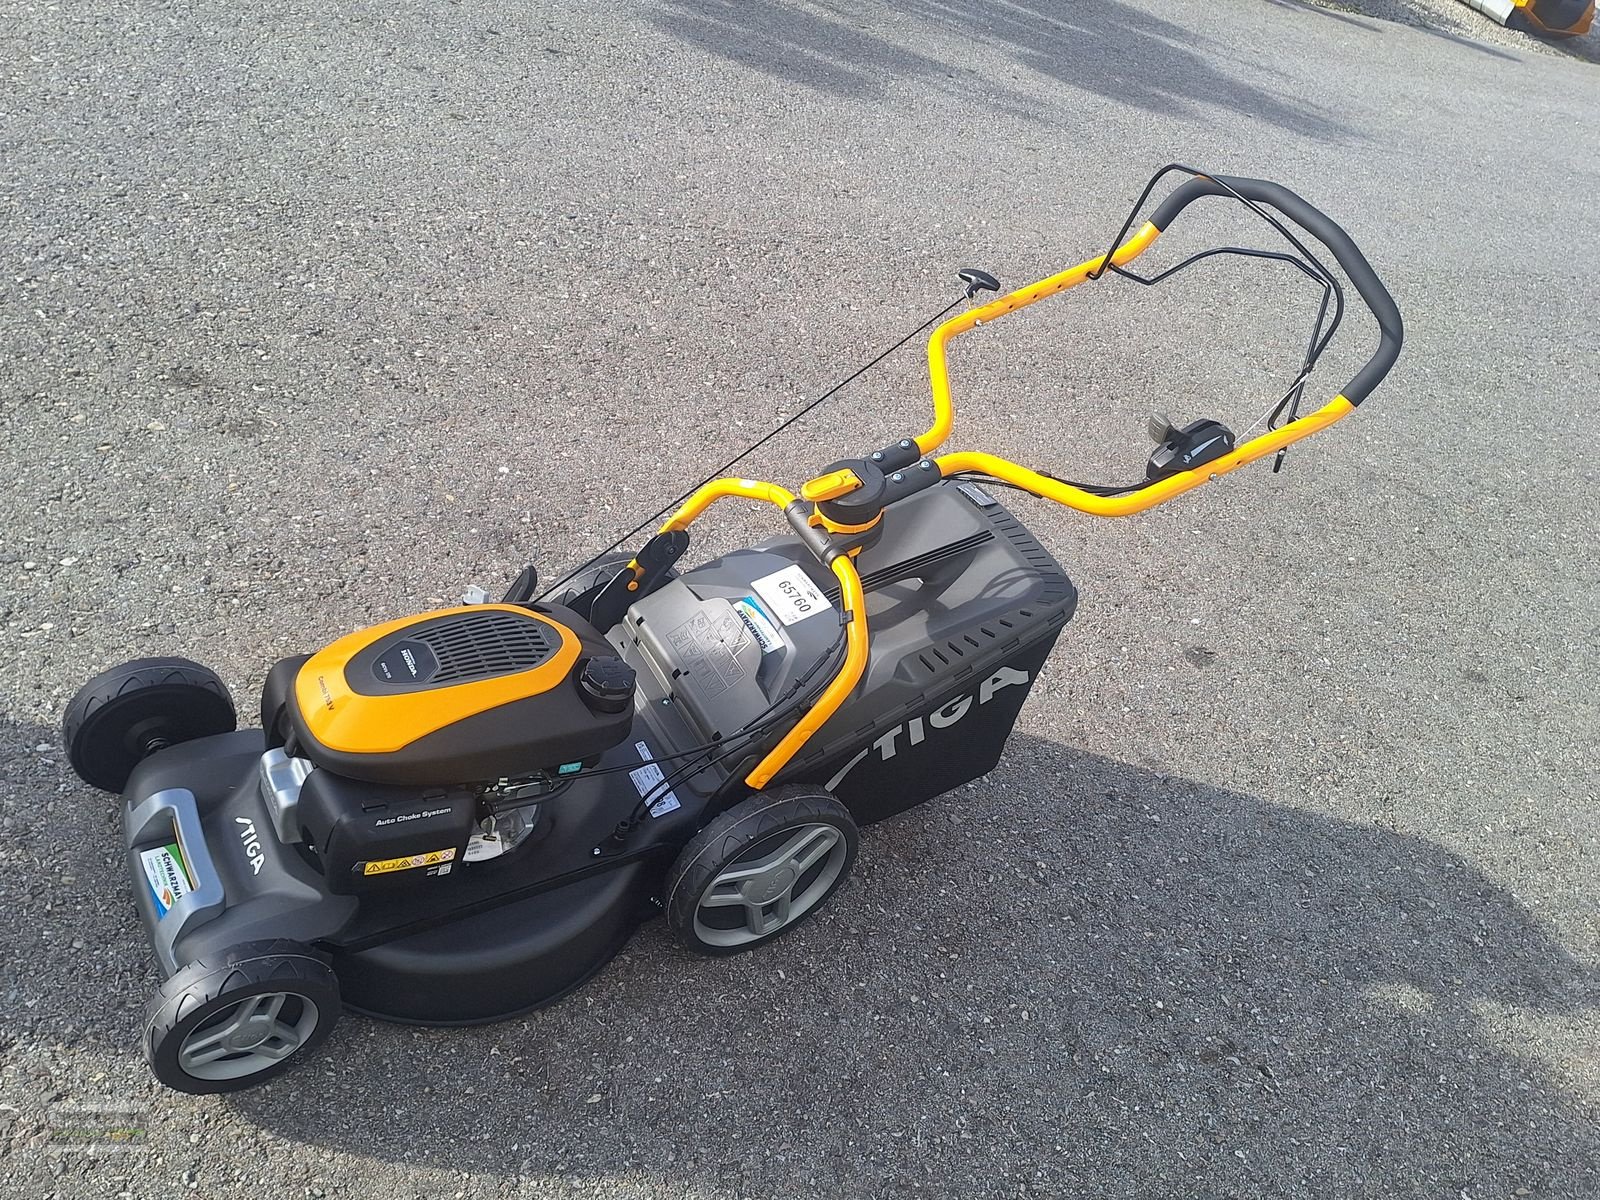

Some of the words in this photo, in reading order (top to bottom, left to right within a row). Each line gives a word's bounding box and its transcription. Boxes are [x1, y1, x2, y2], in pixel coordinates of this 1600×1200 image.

[778, 580, 811, 612] 65760
[401, 649, 417, 678] HONDA
[824, 666, 1029, 792] STIGA
[375, 817, 395, 826] Auto
[397, 812, 421, 822] Choke
[422, 807, 452, 818] System
[235, 816, 265, 875] STIGA
